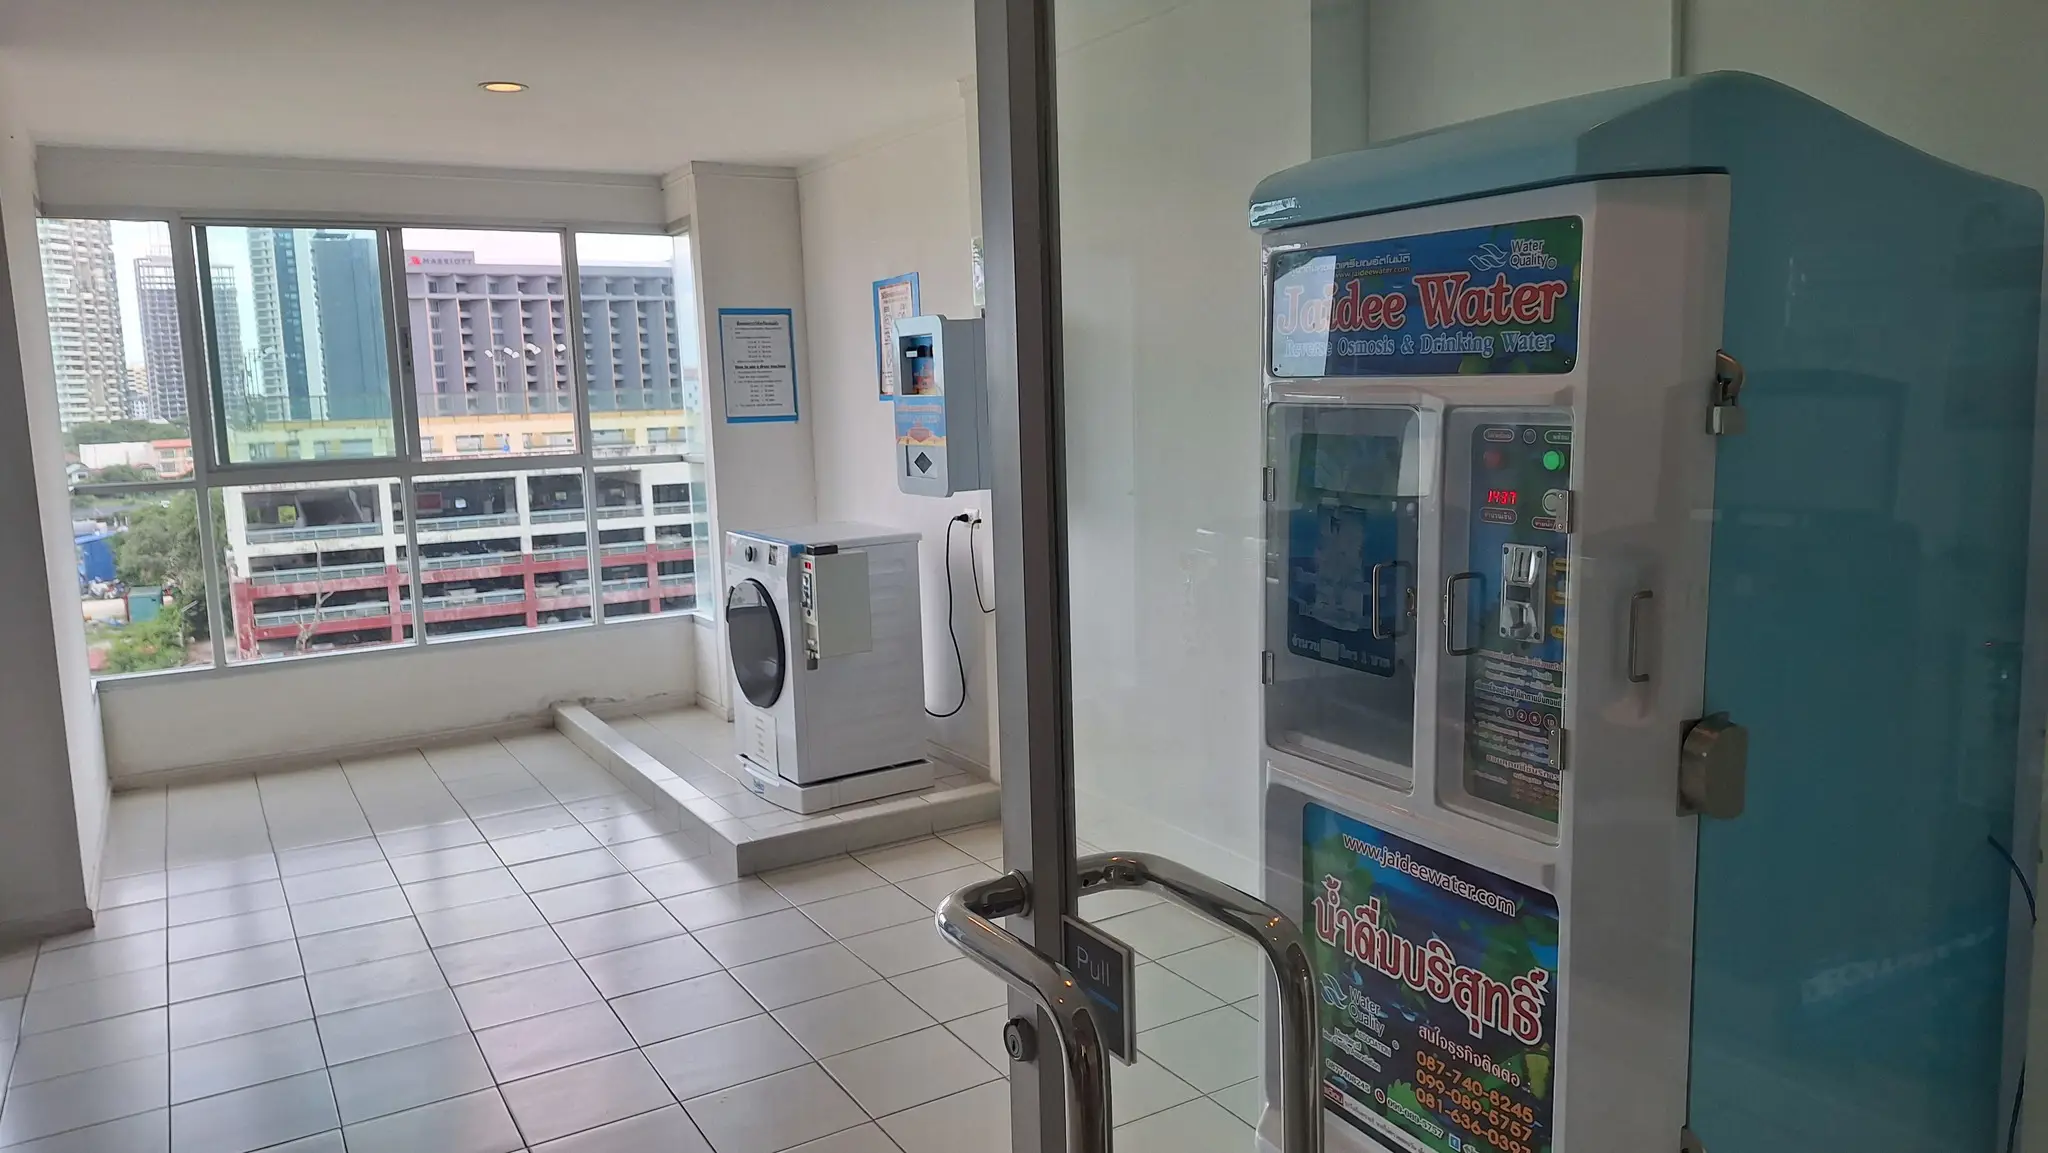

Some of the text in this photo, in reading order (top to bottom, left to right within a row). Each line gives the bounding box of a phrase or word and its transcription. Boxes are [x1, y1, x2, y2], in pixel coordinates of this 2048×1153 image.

[422, 257, 472, 265] MARRIOTT
[1509, 252, 1549, 270] Quality
[1510, 239, 1546, 254] Water
[1277, 270, 1568, 335] Jaidee Water
[1284, 330, 1555, 358] Reverse Osmosis & Drinking Water
[1343, 833, 1516, 917] www.jaideewater.com
[1076, 946, 1111, 987] Pull
[1347, 1001, 1385, 1038] Quality
[1348, 985, 1381, 1015] Water
[1325, 1057, 1371, 1094] 0877408245
[1415, 1050, 1534, 1124] 087-740-8245
[1387, 1096, 1445, 1139] 099-089-5757
[1415, 1068, 1533, 1142] 099-089-5757
[1415, 1087, 1531, 1153] 081-636-0397
